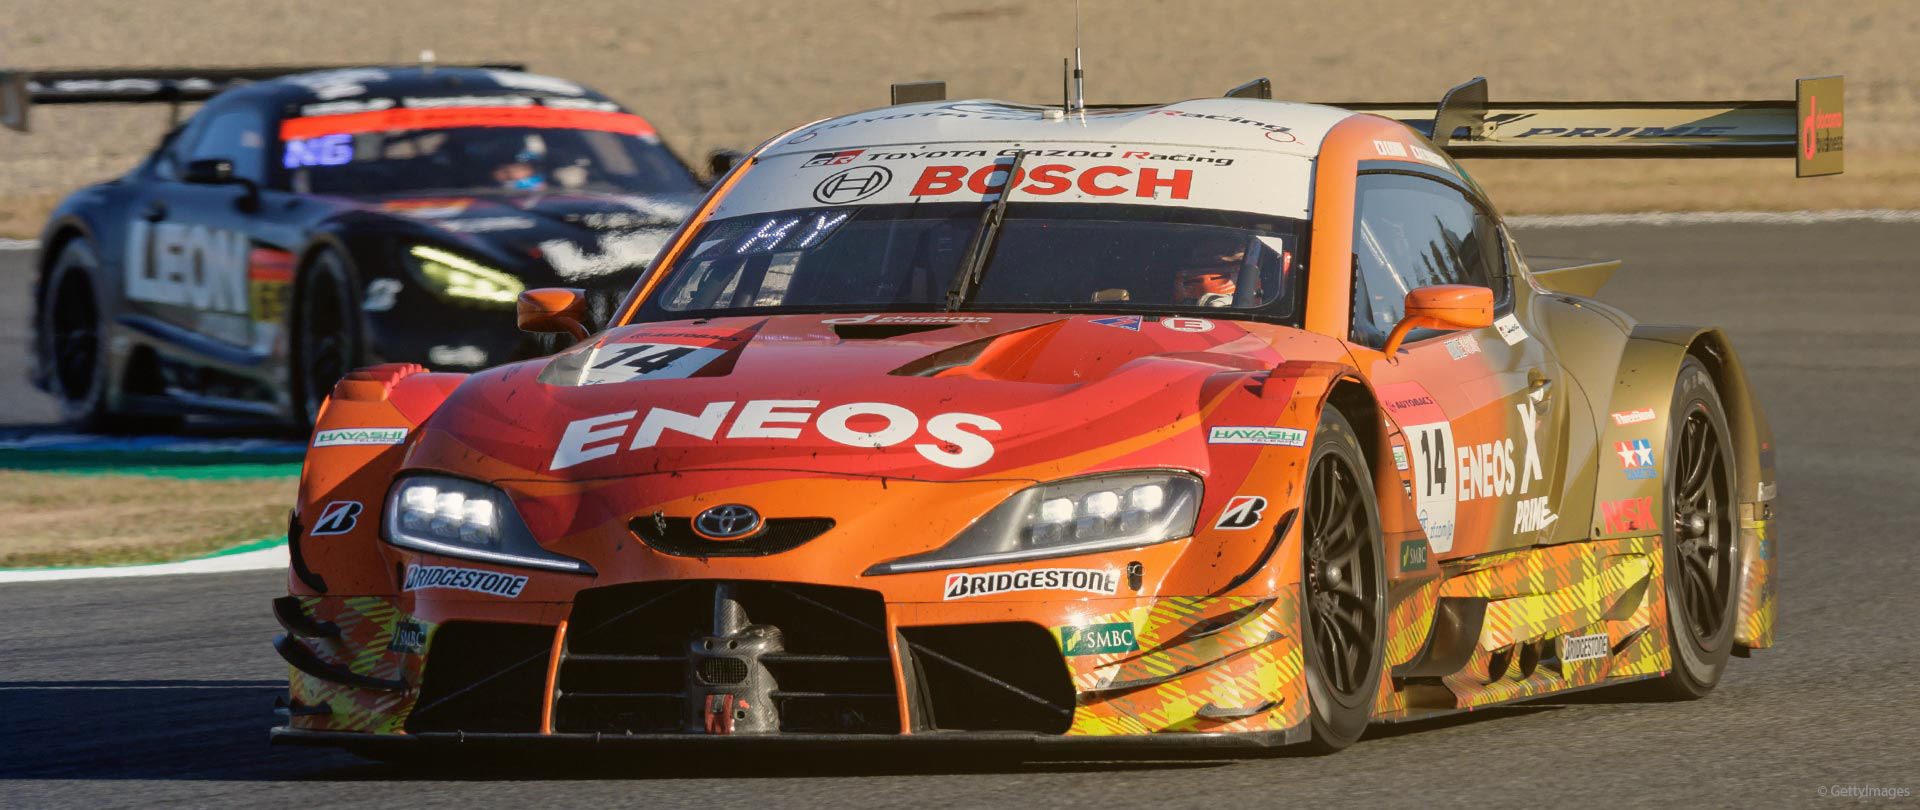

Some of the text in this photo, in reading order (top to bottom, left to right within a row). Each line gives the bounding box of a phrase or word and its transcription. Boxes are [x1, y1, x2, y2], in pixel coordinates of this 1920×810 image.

[1148, 109, 1292, 133] Racing
[1514, 127, 1737, 137] PRIME
[868, 148, 1234, 166] TOYOTA GAZOO Racing
[909, 164, 1193, 199] BOSCH
[126, 220, 248, 314] LEON
[592, 345, 697, 374] 14
[1395, 396, 1433, 409] AUTOBACS
[320, 431, 403, 441] HAYASHI
[549, 400, 1002, 470] ENEOS
[1214, 430, 1301, 440] HAYASHI
[1421, 428, 1447, 496] 14
[1457, 438, 1515, 502] ENEOS
[1513, 496, 1558, 534] PRIME
[1600, 497, 1657, 534] NSK
[1410, 547, 1426, 564] SMBC
[405, 566, 527, 596] BRIDGESTONE
[946, 570, 1117, 598] BRIDGESTONE
[400, 631, 424, 648] SMBC
[1087, 629, 1132, 648] SMBC
[1565, 635, 1607, 660] BRIDGESTONE
